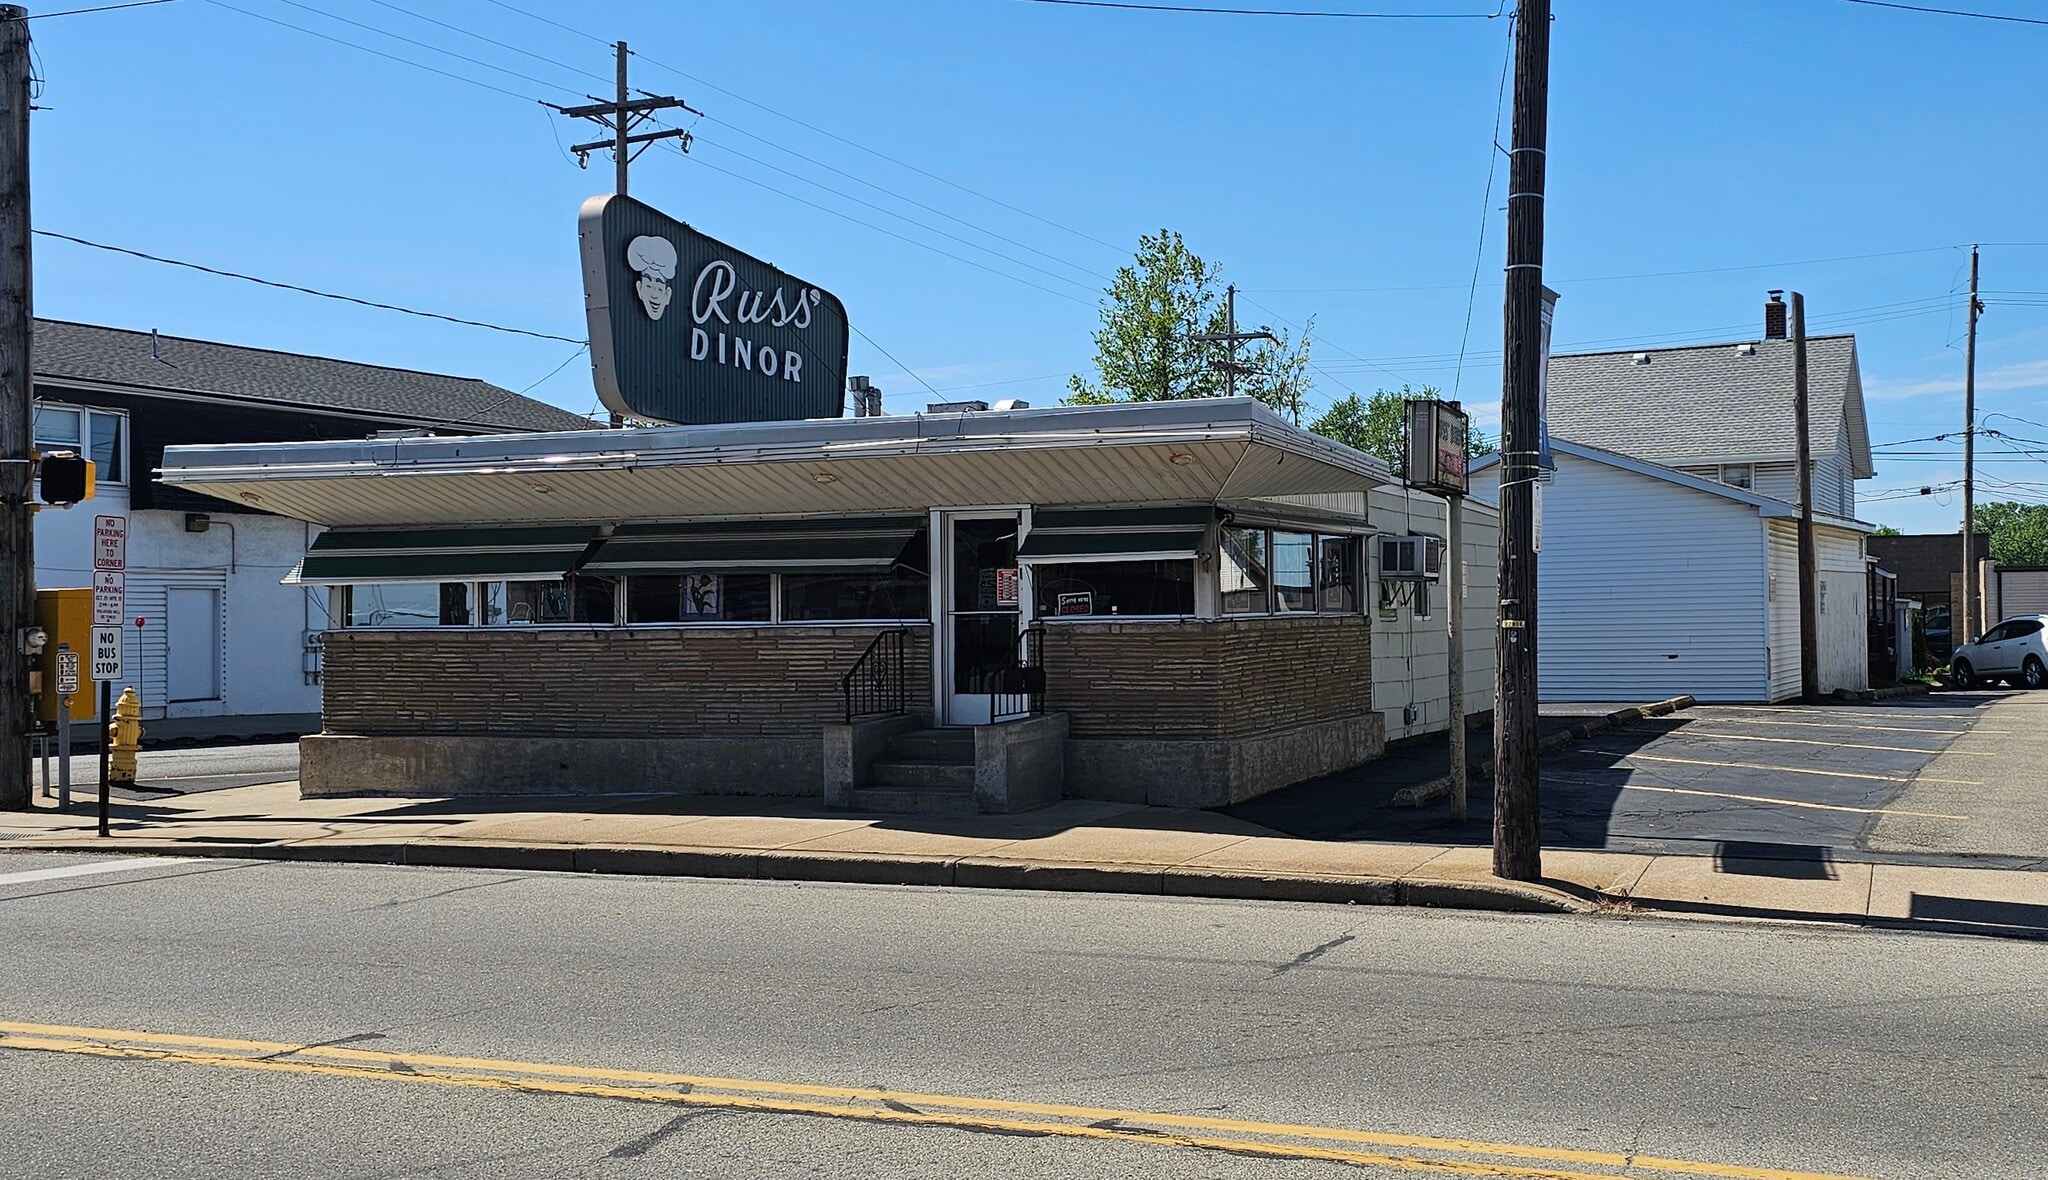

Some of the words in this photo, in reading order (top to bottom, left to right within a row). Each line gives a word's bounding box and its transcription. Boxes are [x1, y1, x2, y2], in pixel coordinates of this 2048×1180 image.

[691, 328, 803, 382] DINOR
[105, 519, 115, 527] NO
[97, 528, 124, 538] PARKING
[101, 539, 118, 547] HERE
[106, 549, 114, 557] TO
[97, 559, 122, 567] CORNER
[105, 576, 113, 584] NO
[96, 586, 122, 594] PARKING
[1061, 604, 1089, 614] CLOSED
[100, 632, 115, 644] NO
[98, 647, 116, 659] BUS
[95, 662, 119, 674] STOP
